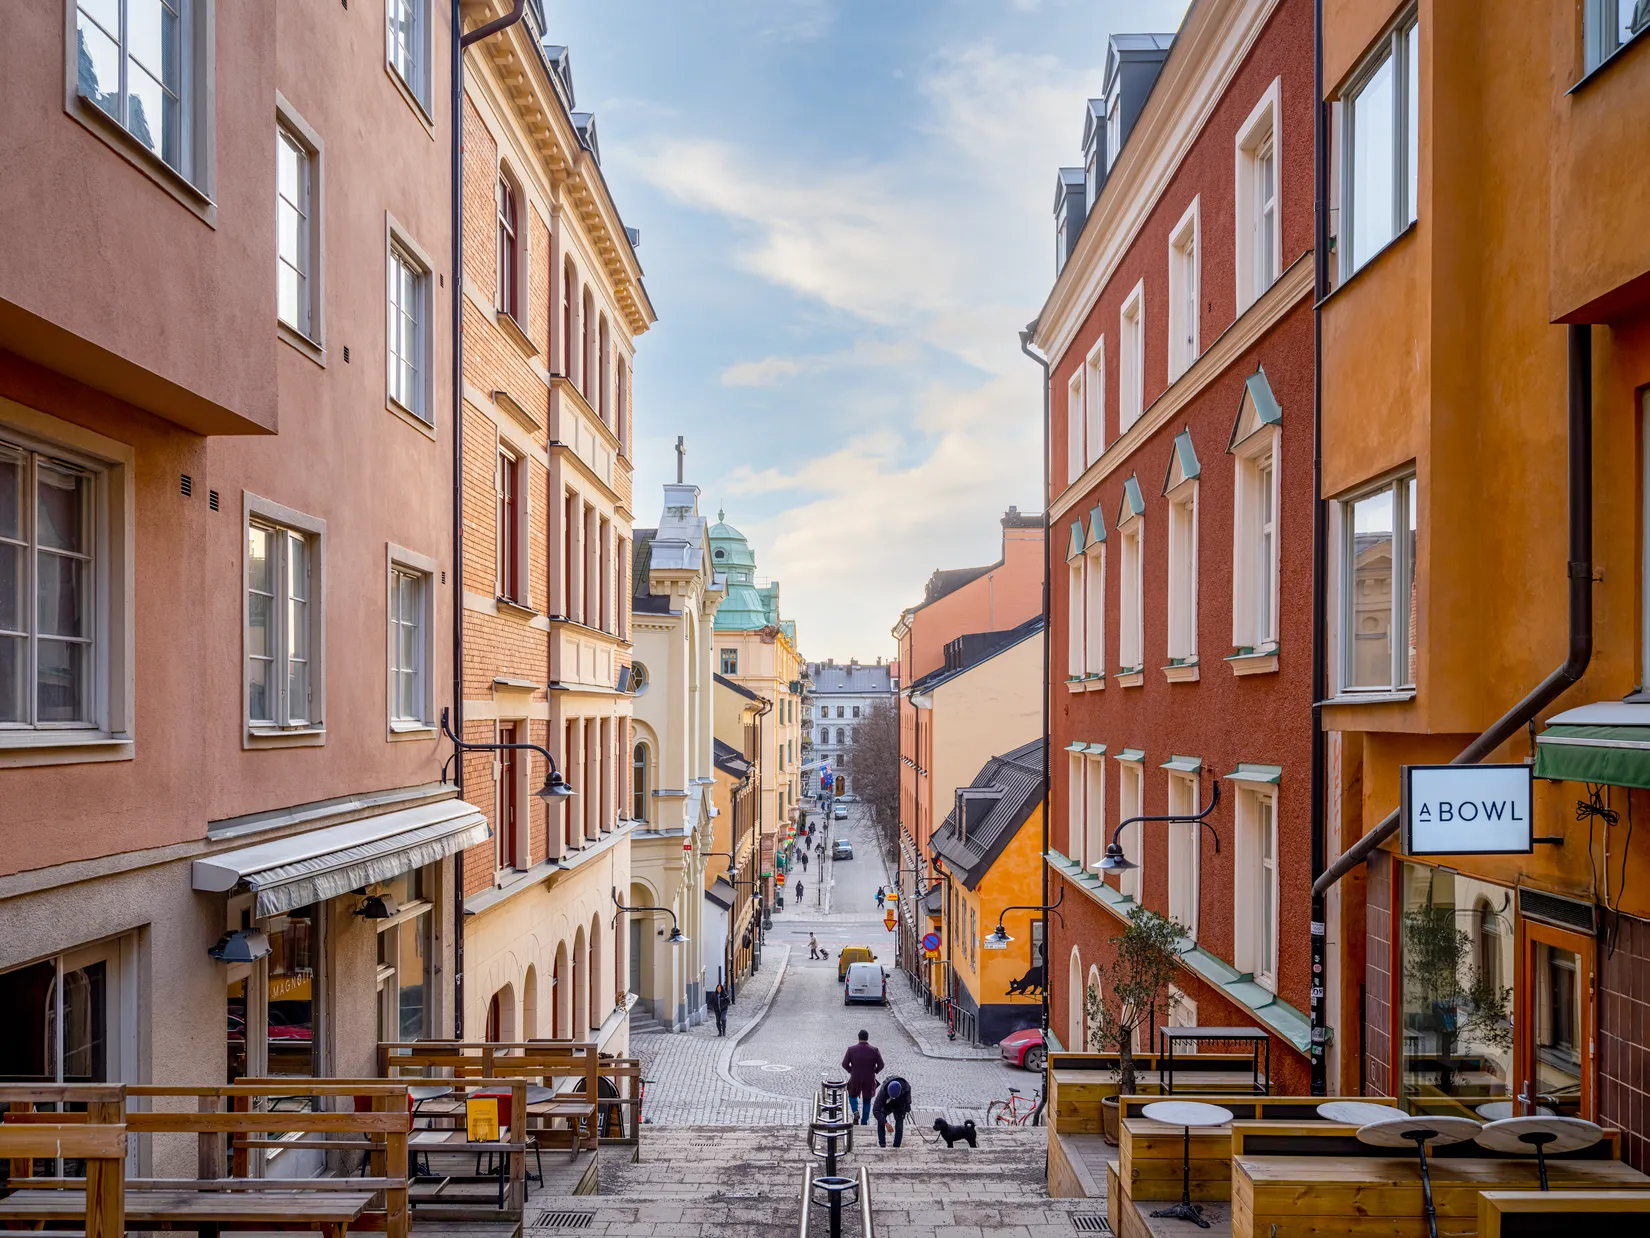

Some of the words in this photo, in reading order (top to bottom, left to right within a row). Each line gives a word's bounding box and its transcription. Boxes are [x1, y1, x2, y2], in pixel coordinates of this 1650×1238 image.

[1419, 802, 1431, 821] A
[1439, 801, 1523, 822] BOWL
[272, 968, 314, 998] MAGNOLIA
